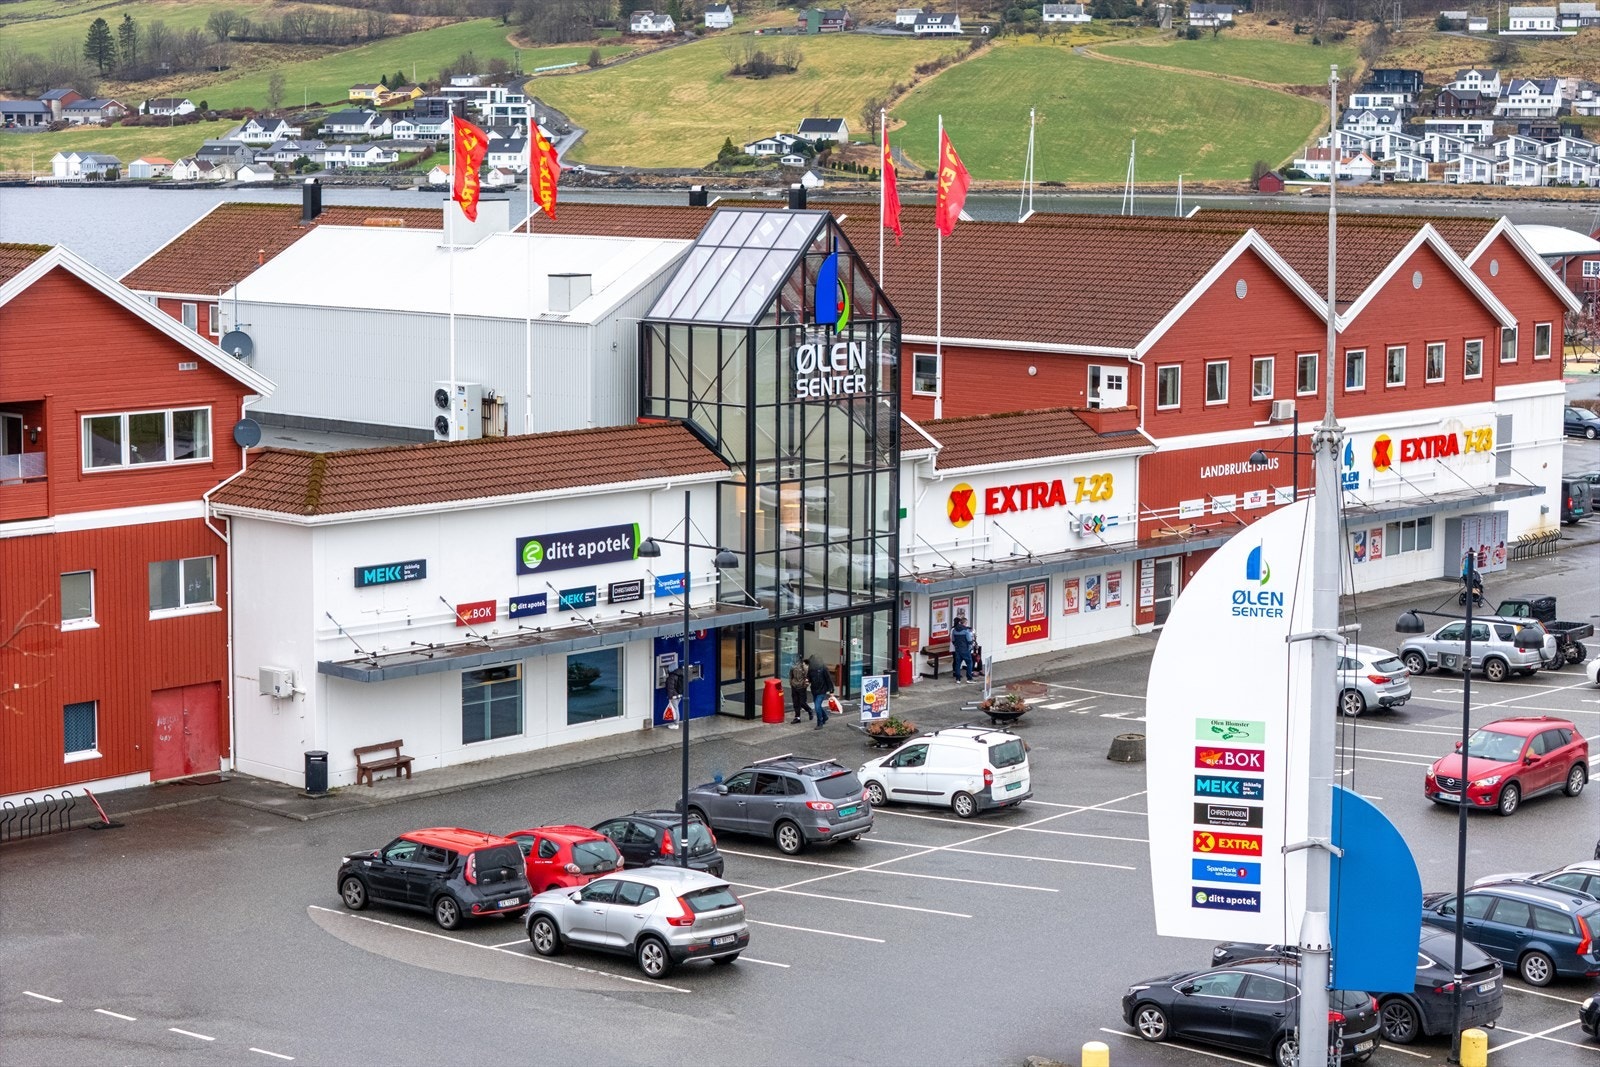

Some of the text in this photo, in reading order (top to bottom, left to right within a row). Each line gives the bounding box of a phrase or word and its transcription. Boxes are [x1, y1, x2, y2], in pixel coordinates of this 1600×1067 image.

[796, 341, 867, 375] ØLEN
[796, 374, 867, 398] SENTER
[1400, 433, 1460, 463] EXTRA
[1464, 427, 1494, 454] 7-23
[985, 479, 1067, 516] EXTRA
[1073, 472, 1114, 504] 7-23
[546, 533, 630, 560] ditt apotek
[528, 600, 546, 609] apotek
[1232, 590, 1284, 606] ØLEN
[473, 606, 492, 618] BOK
[1232, 606, 1284, 618] SENTER
[1023, 624, 1042, 634] EXTRA
[1225, 751, 1261, 767] BOK
[1210, 808, 1247, 818] CHRISTIANSEN
[1218, 838, 1260, 851] EXTRA
[1206, 865, 1237, 873] SpareBank
[1208, 894, 1257, 906] ditt apotek
